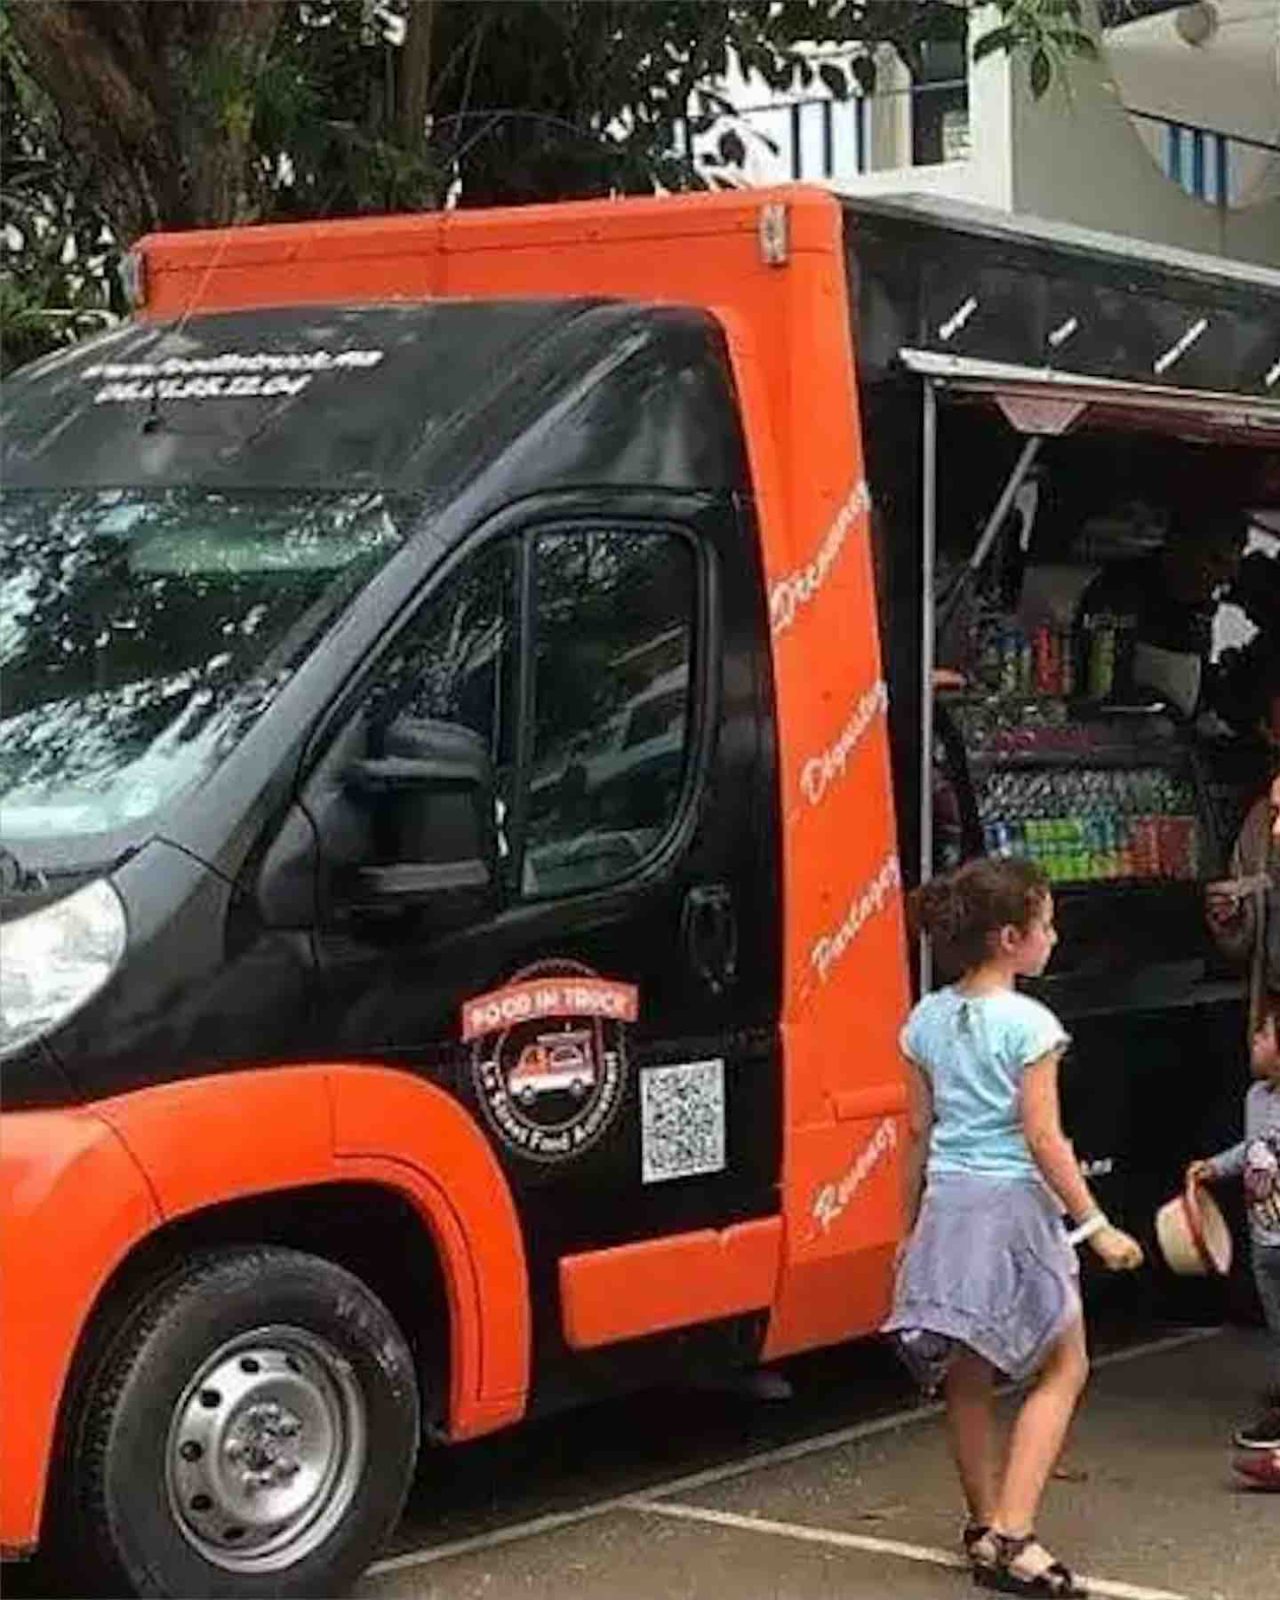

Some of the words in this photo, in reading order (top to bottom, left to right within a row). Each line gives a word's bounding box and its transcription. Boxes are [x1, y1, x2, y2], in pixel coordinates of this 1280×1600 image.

[471, 996, 531, 1026] FOOD
[535, 992, 559, 1010] IN
[564, 988, 628, 1014] TRUCK
